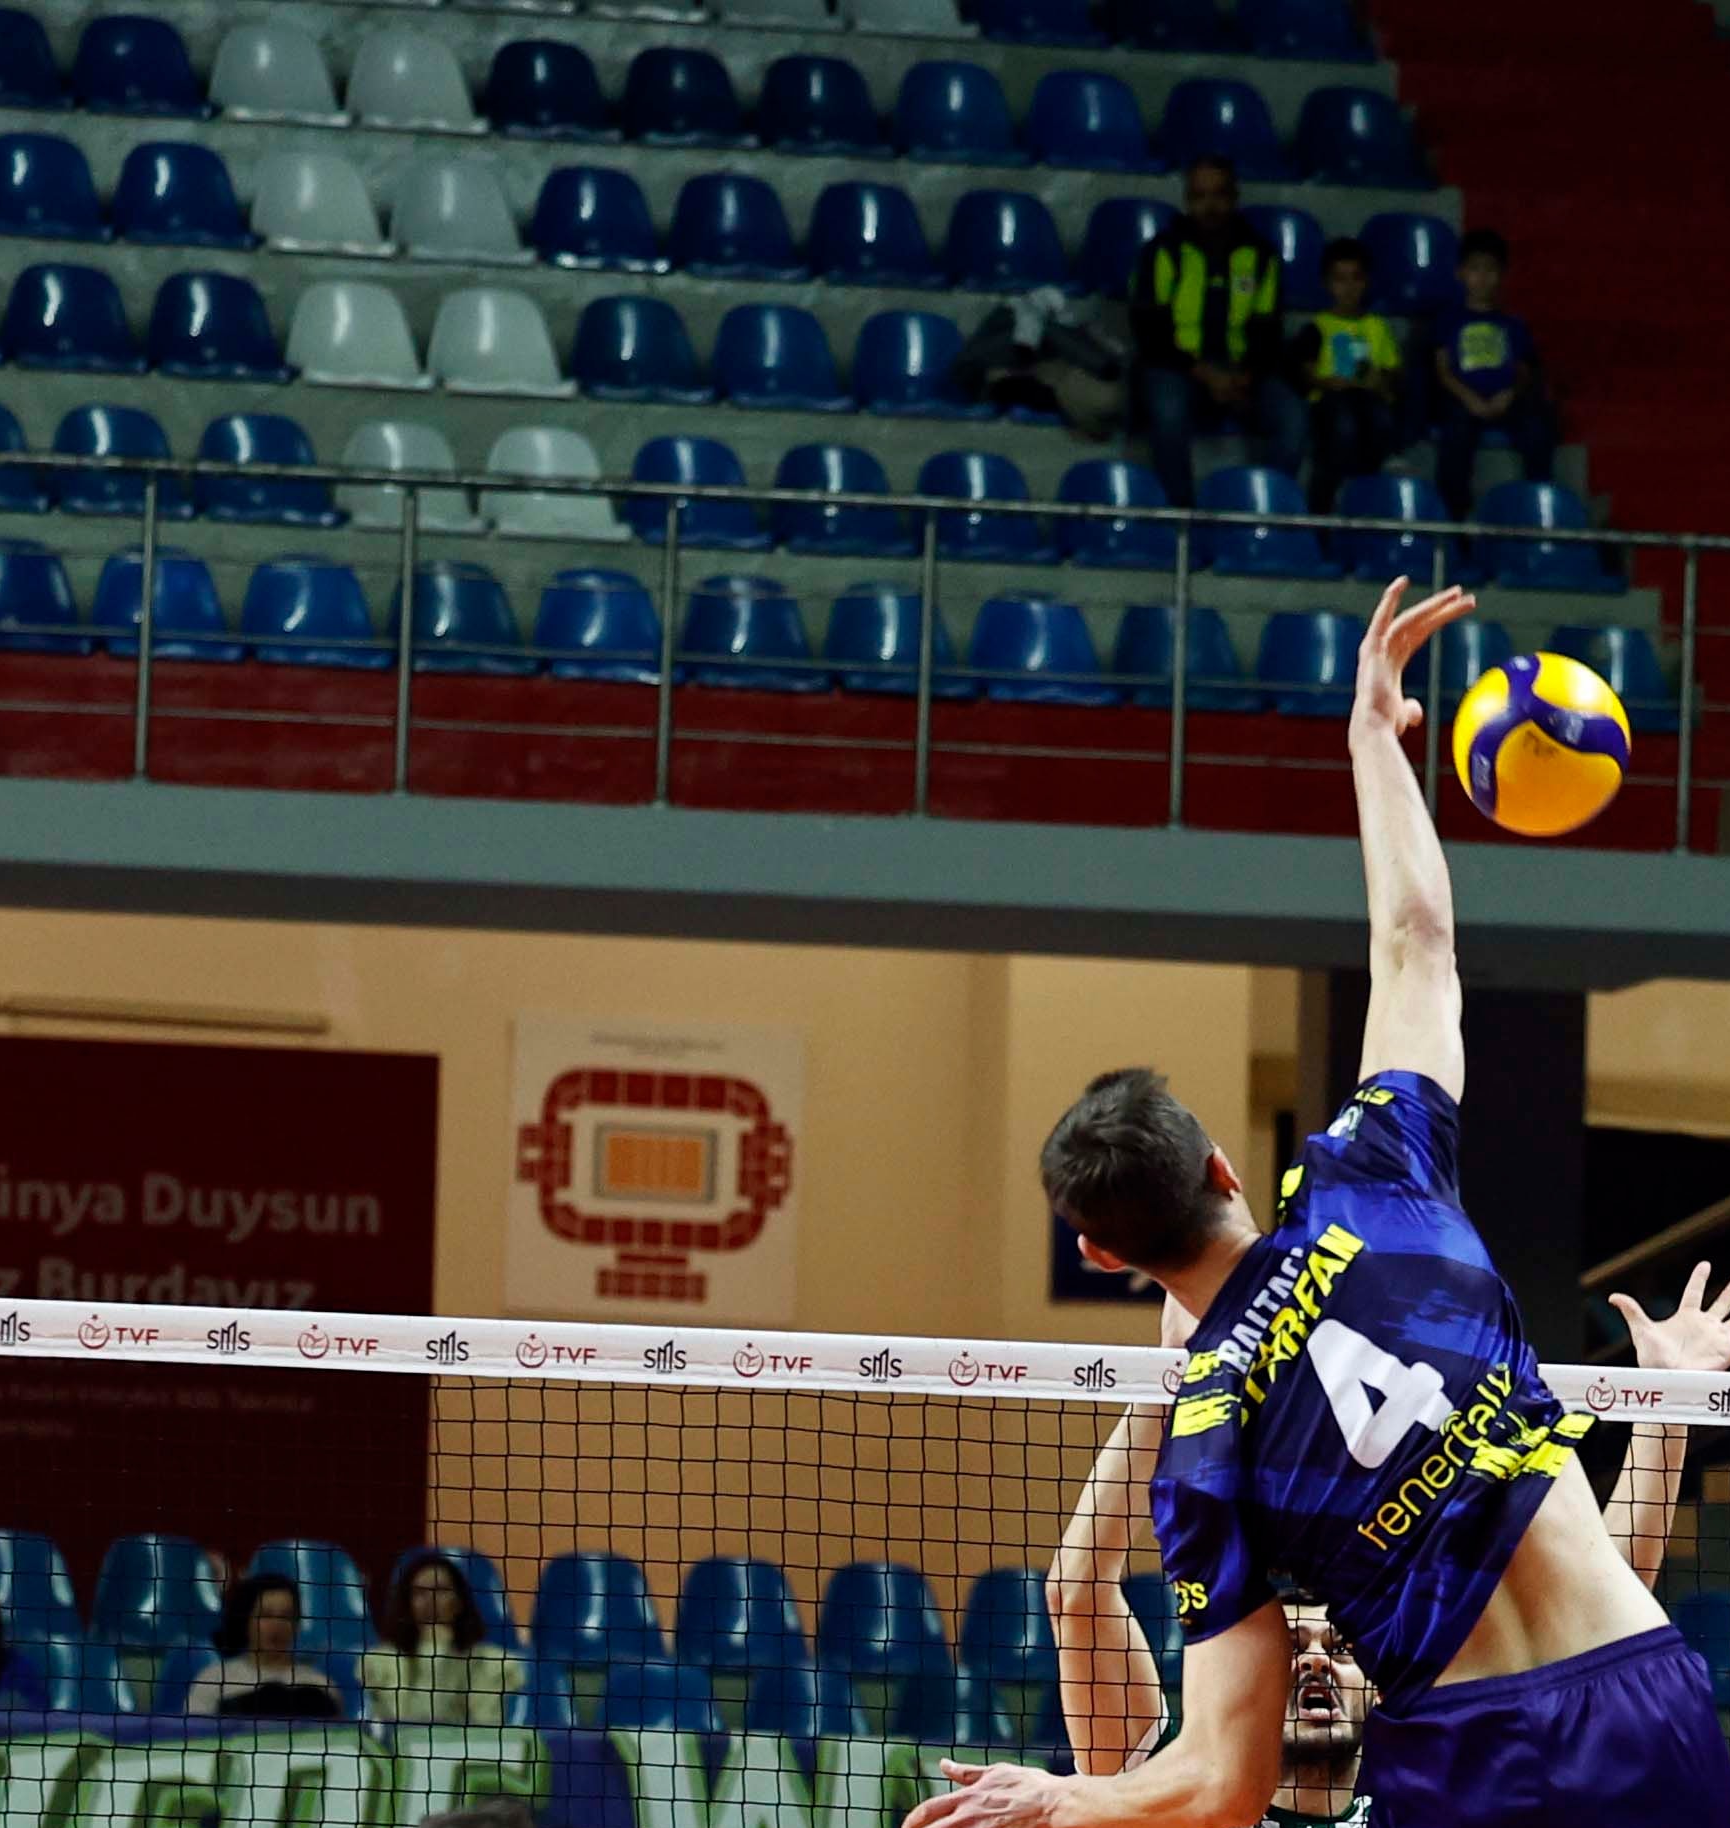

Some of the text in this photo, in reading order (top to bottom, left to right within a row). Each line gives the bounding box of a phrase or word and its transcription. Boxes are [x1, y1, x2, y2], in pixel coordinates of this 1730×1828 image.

[141, 1168, 382, 1244] Duysun
[113, 1328, 159, 1347] TVF
[206, 1320, 251, 1354] SMS
[333, 1337, 379, 1356] TVF
[426, 1329, 470, 1363] SMS
[551, 1347, 597, 1365] TVF
[643, 1338, 687, 1372] SMS
[767, 1356, 812, 1374] TVF
[858, 1348, 903, 1381] SMS
[983, 1365, 1028, 1384] TVF
[1073, 1357, 1117, 1390] SMS
[1305, 1317, 1455, 1470] 4
[1619, 1391, 1664, 1410] TVF
